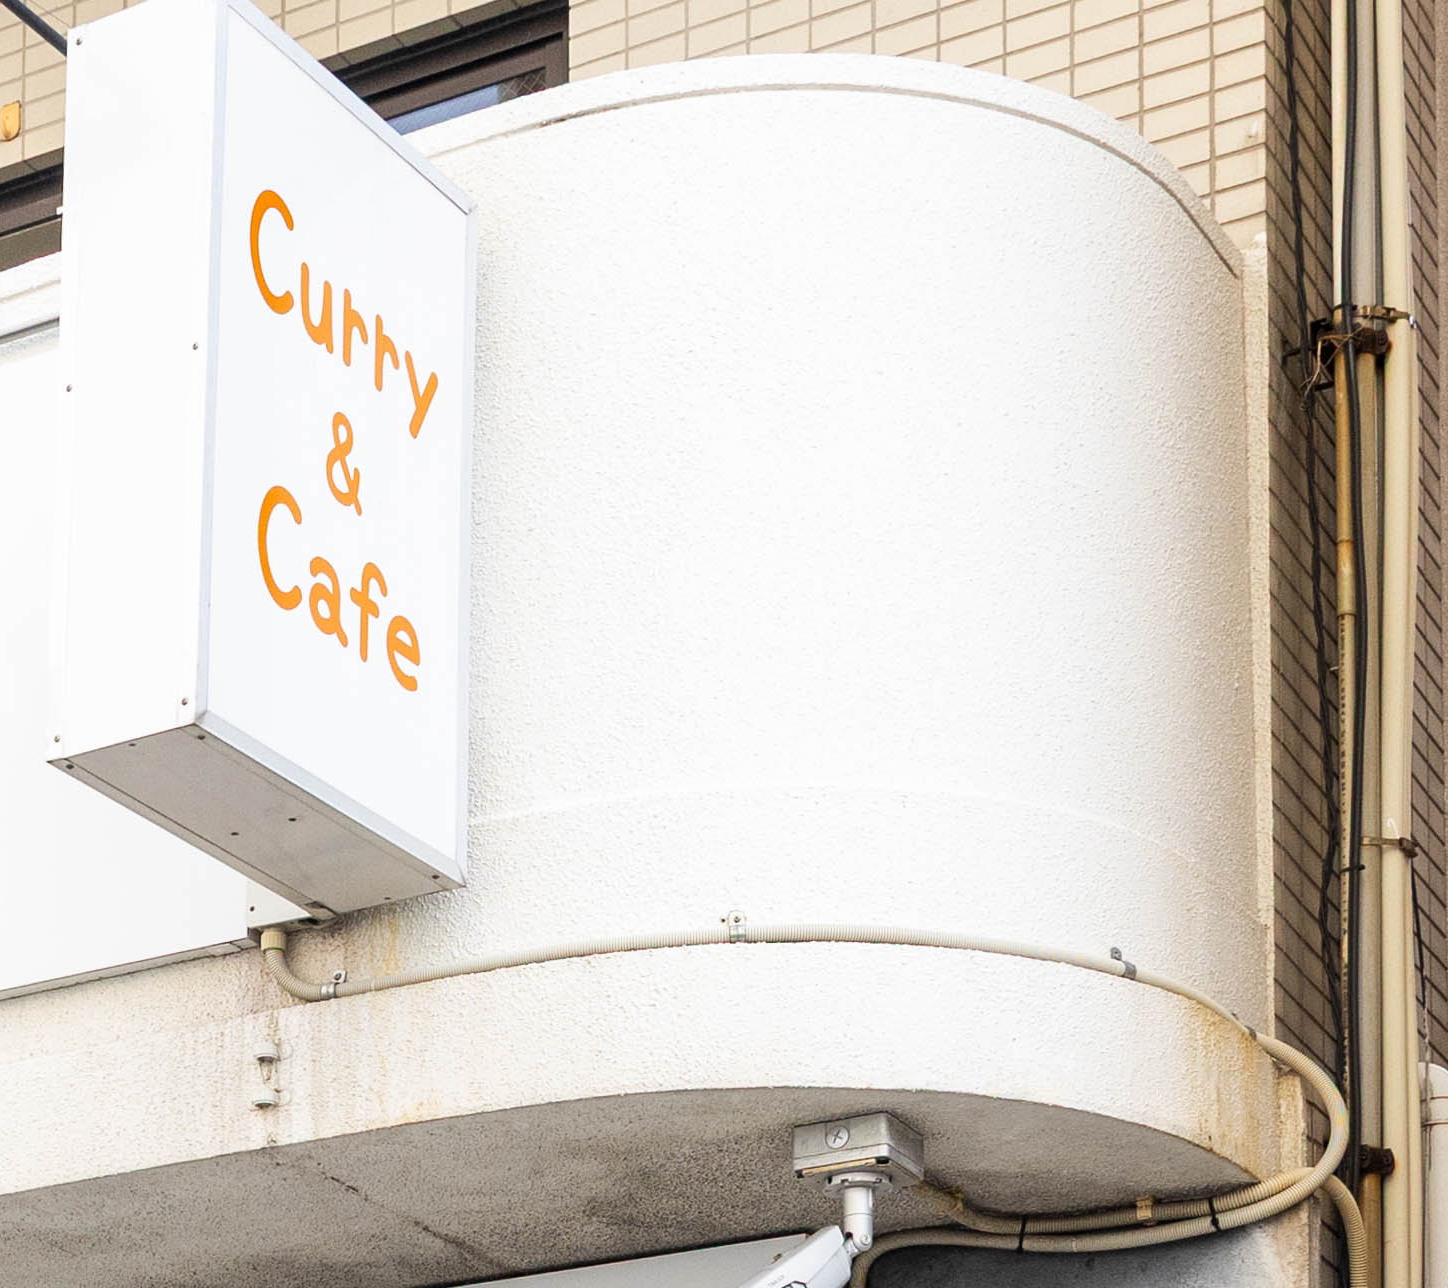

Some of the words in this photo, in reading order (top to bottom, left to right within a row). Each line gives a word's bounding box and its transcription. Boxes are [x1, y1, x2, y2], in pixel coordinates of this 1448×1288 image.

[249, 188, 439, 439] Curry
[325, 411, 362, 516] &
[256, 485, 421, 692] Cafe
